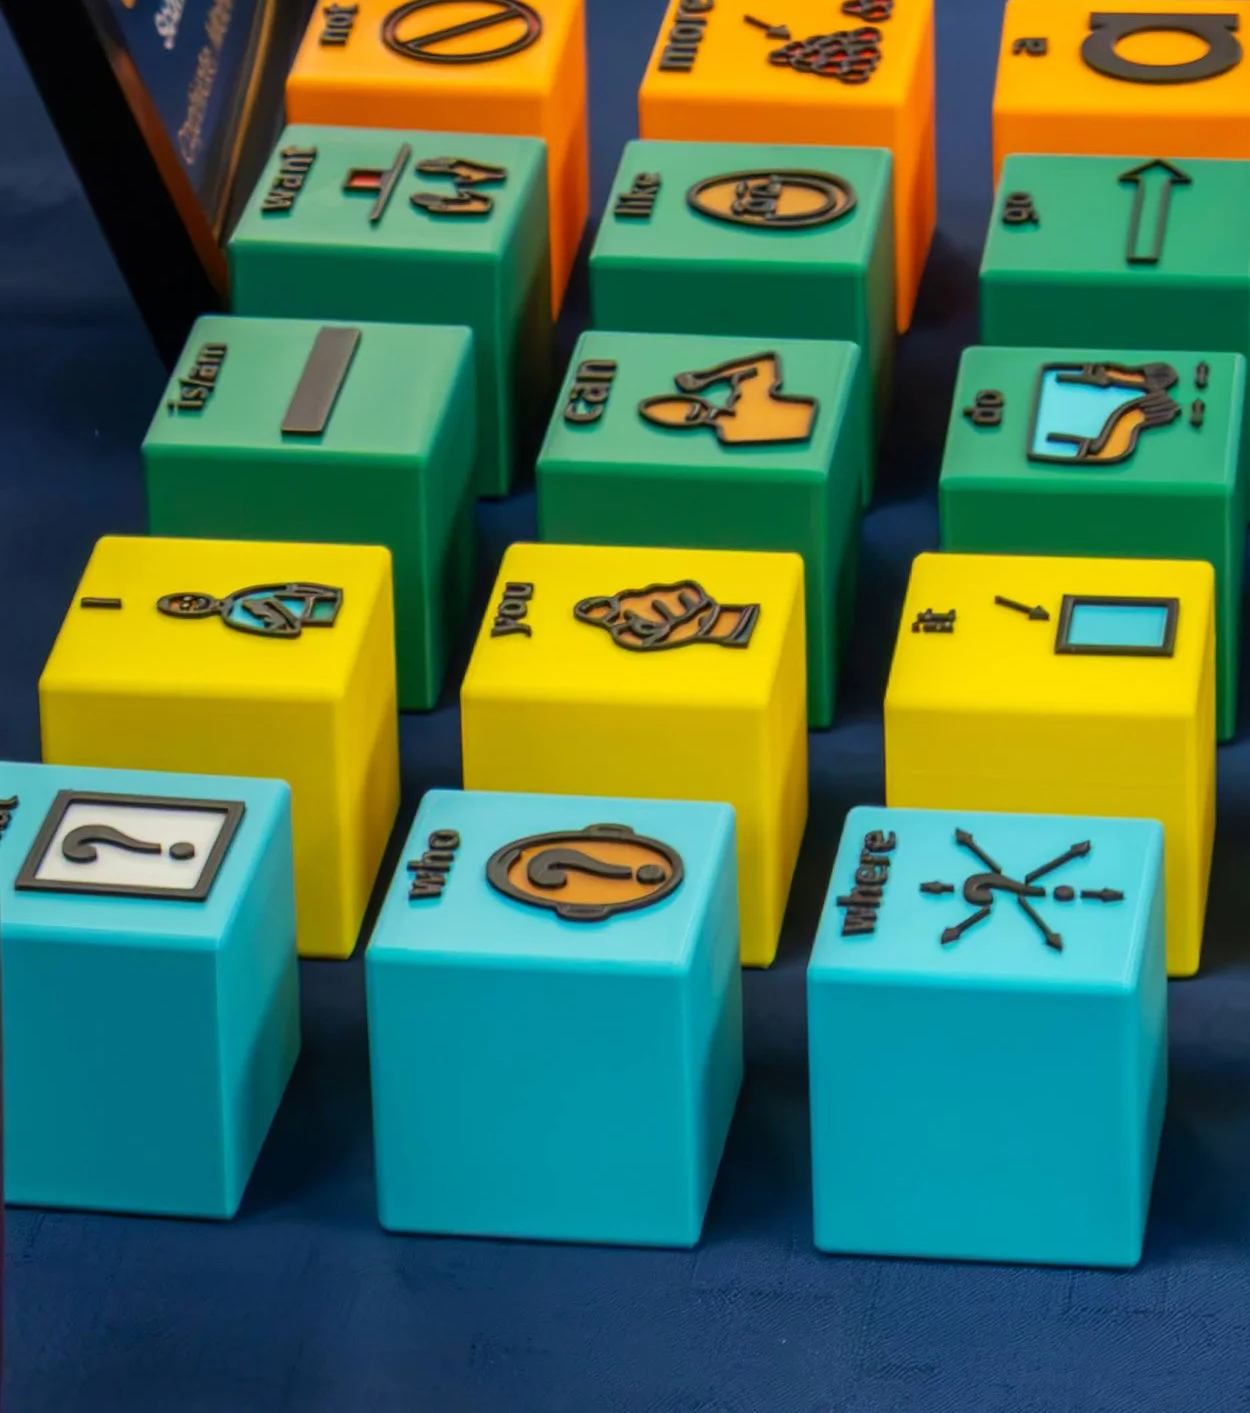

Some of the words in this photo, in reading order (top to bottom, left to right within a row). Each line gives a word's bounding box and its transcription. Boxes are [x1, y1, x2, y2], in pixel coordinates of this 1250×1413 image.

[319, 3, 358, 47] not
[1013, 37, 1048, 56] a
[261, 145, 317, 215] want
[613, 172, 661, 218] like
[1002, 192, 1039, 229] go
[563, 359, 617, 425] can
[963, 391, 1004, 426] do
[490, 581, 533, 637] you
[911, 608, 957, 634] it
[407, 828, 462, 902] who
[836, 828, 896, 938] where
